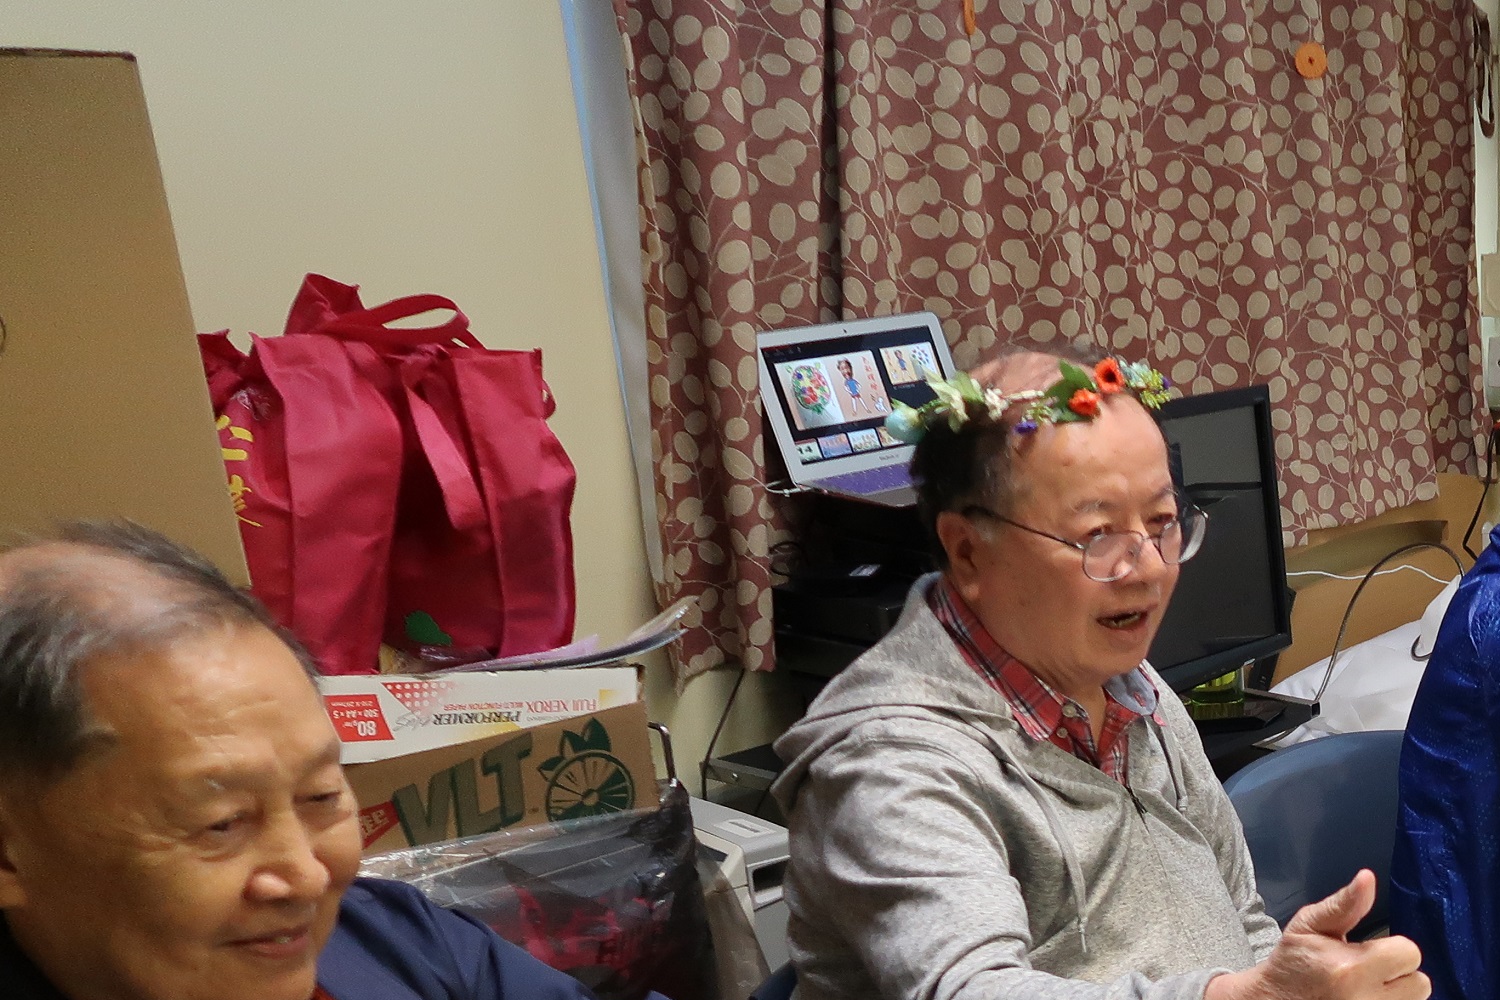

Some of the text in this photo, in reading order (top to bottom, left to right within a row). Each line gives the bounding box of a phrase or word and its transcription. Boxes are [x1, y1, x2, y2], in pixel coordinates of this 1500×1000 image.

[443, 703, 467, 711] PAPER
[526, 699, 597, 713] FUJI XEROX
[433, 711, 523, 725] PERFORMER
[392, 732, 532, 847] VLT
